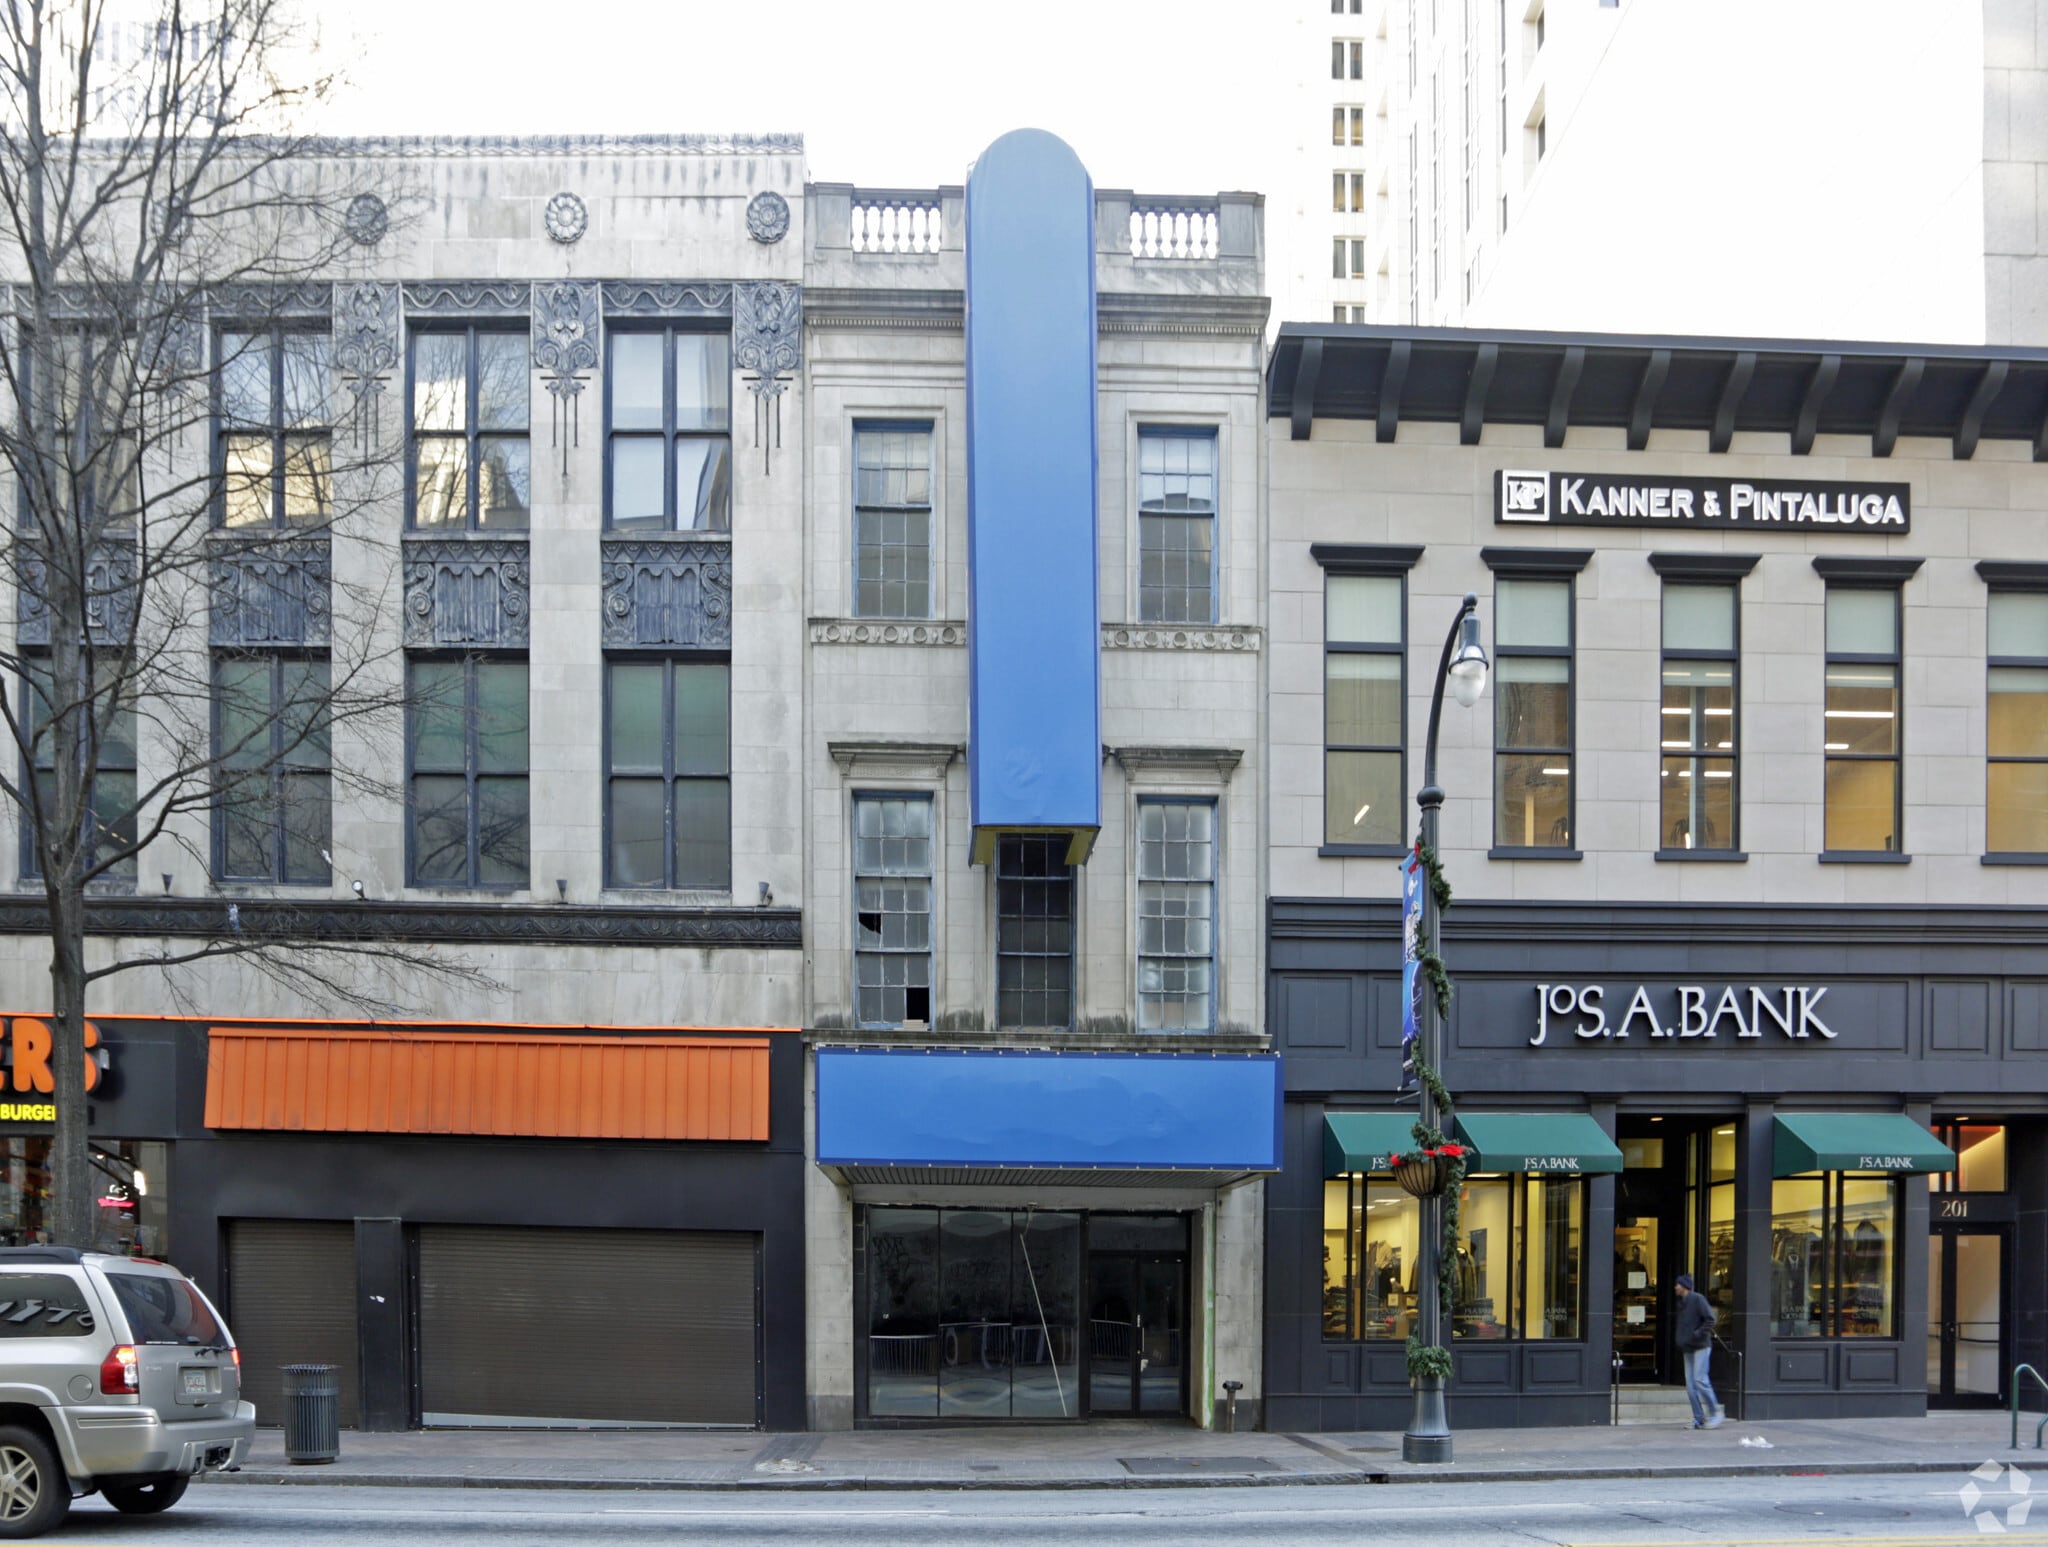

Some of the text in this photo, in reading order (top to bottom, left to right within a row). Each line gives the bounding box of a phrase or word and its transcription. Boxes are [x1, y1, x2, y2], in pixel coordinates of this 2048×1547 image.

[1560, 477, 1905, 525] KANNER & PINTALUGA
[1677, 985, 1839, 1039] BANK
[1941, 1200, 1968, 1217] 201
